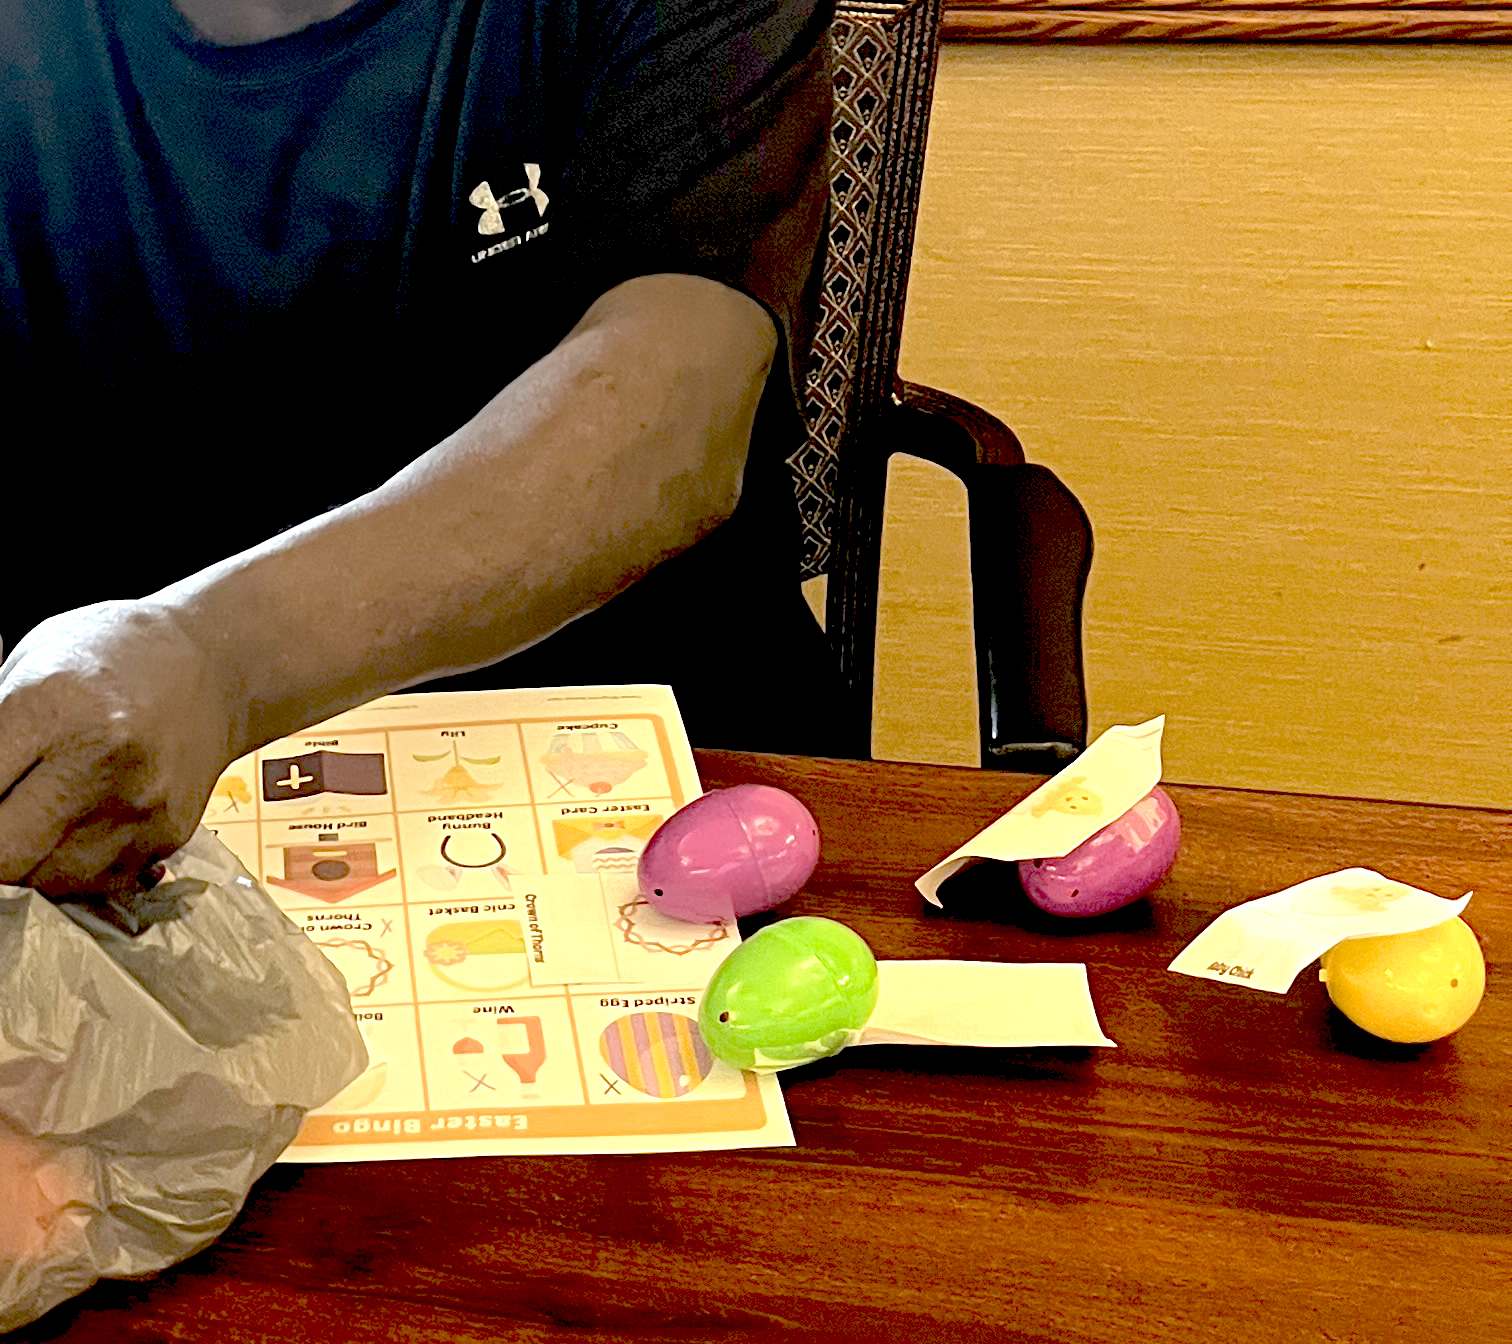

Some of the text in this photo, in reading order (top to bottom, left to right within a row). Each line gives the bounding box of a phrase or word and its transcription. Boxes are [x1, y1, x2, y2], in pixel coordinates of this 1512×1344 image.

[556, 723, 618, 733] Cupcake
[440, 730, 466, 739] Lily
[561, 803, 650, 816] Easter Card
[427, 812, 504, 824] Headband
[288, 821, 367, 831] Bird House
[442, 821, 492, 831] Bunny
[428, 903, 516, 916] cnic Basket
[525, 893, 538, 922] Crown
[307, 913, 362, 923] Thorns
[319, 922, 373, 932] Crown
[599, 997, 697, 1008] Striped Egg
[473, 1005, 515, 1015] Wine
[333, 1114, 528, 1135] Easter Bingo
